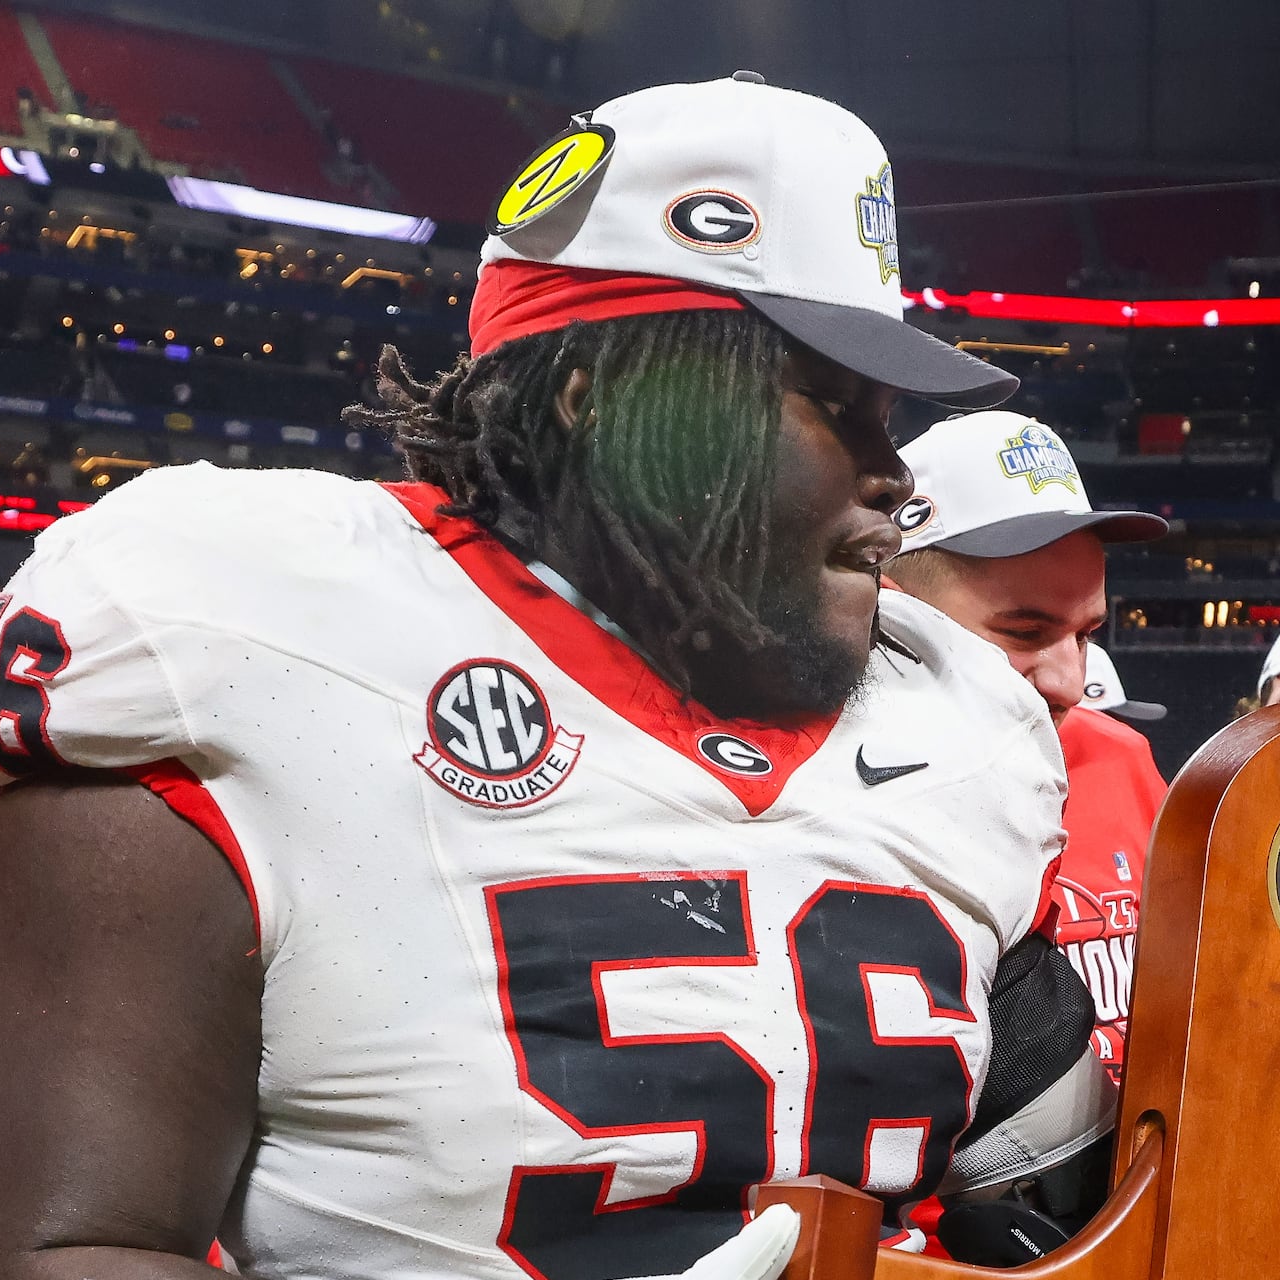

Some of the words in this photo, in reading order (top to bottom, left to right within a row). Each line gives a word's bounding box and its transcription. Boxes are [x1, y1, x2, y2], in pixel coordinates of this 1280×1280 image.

[514, 141, 581, 220] Z
[435, 666, 547, 773] SEC
[440, 751, 570, 803] GRADUATE
[1105, 898, 1133, 930] 25
